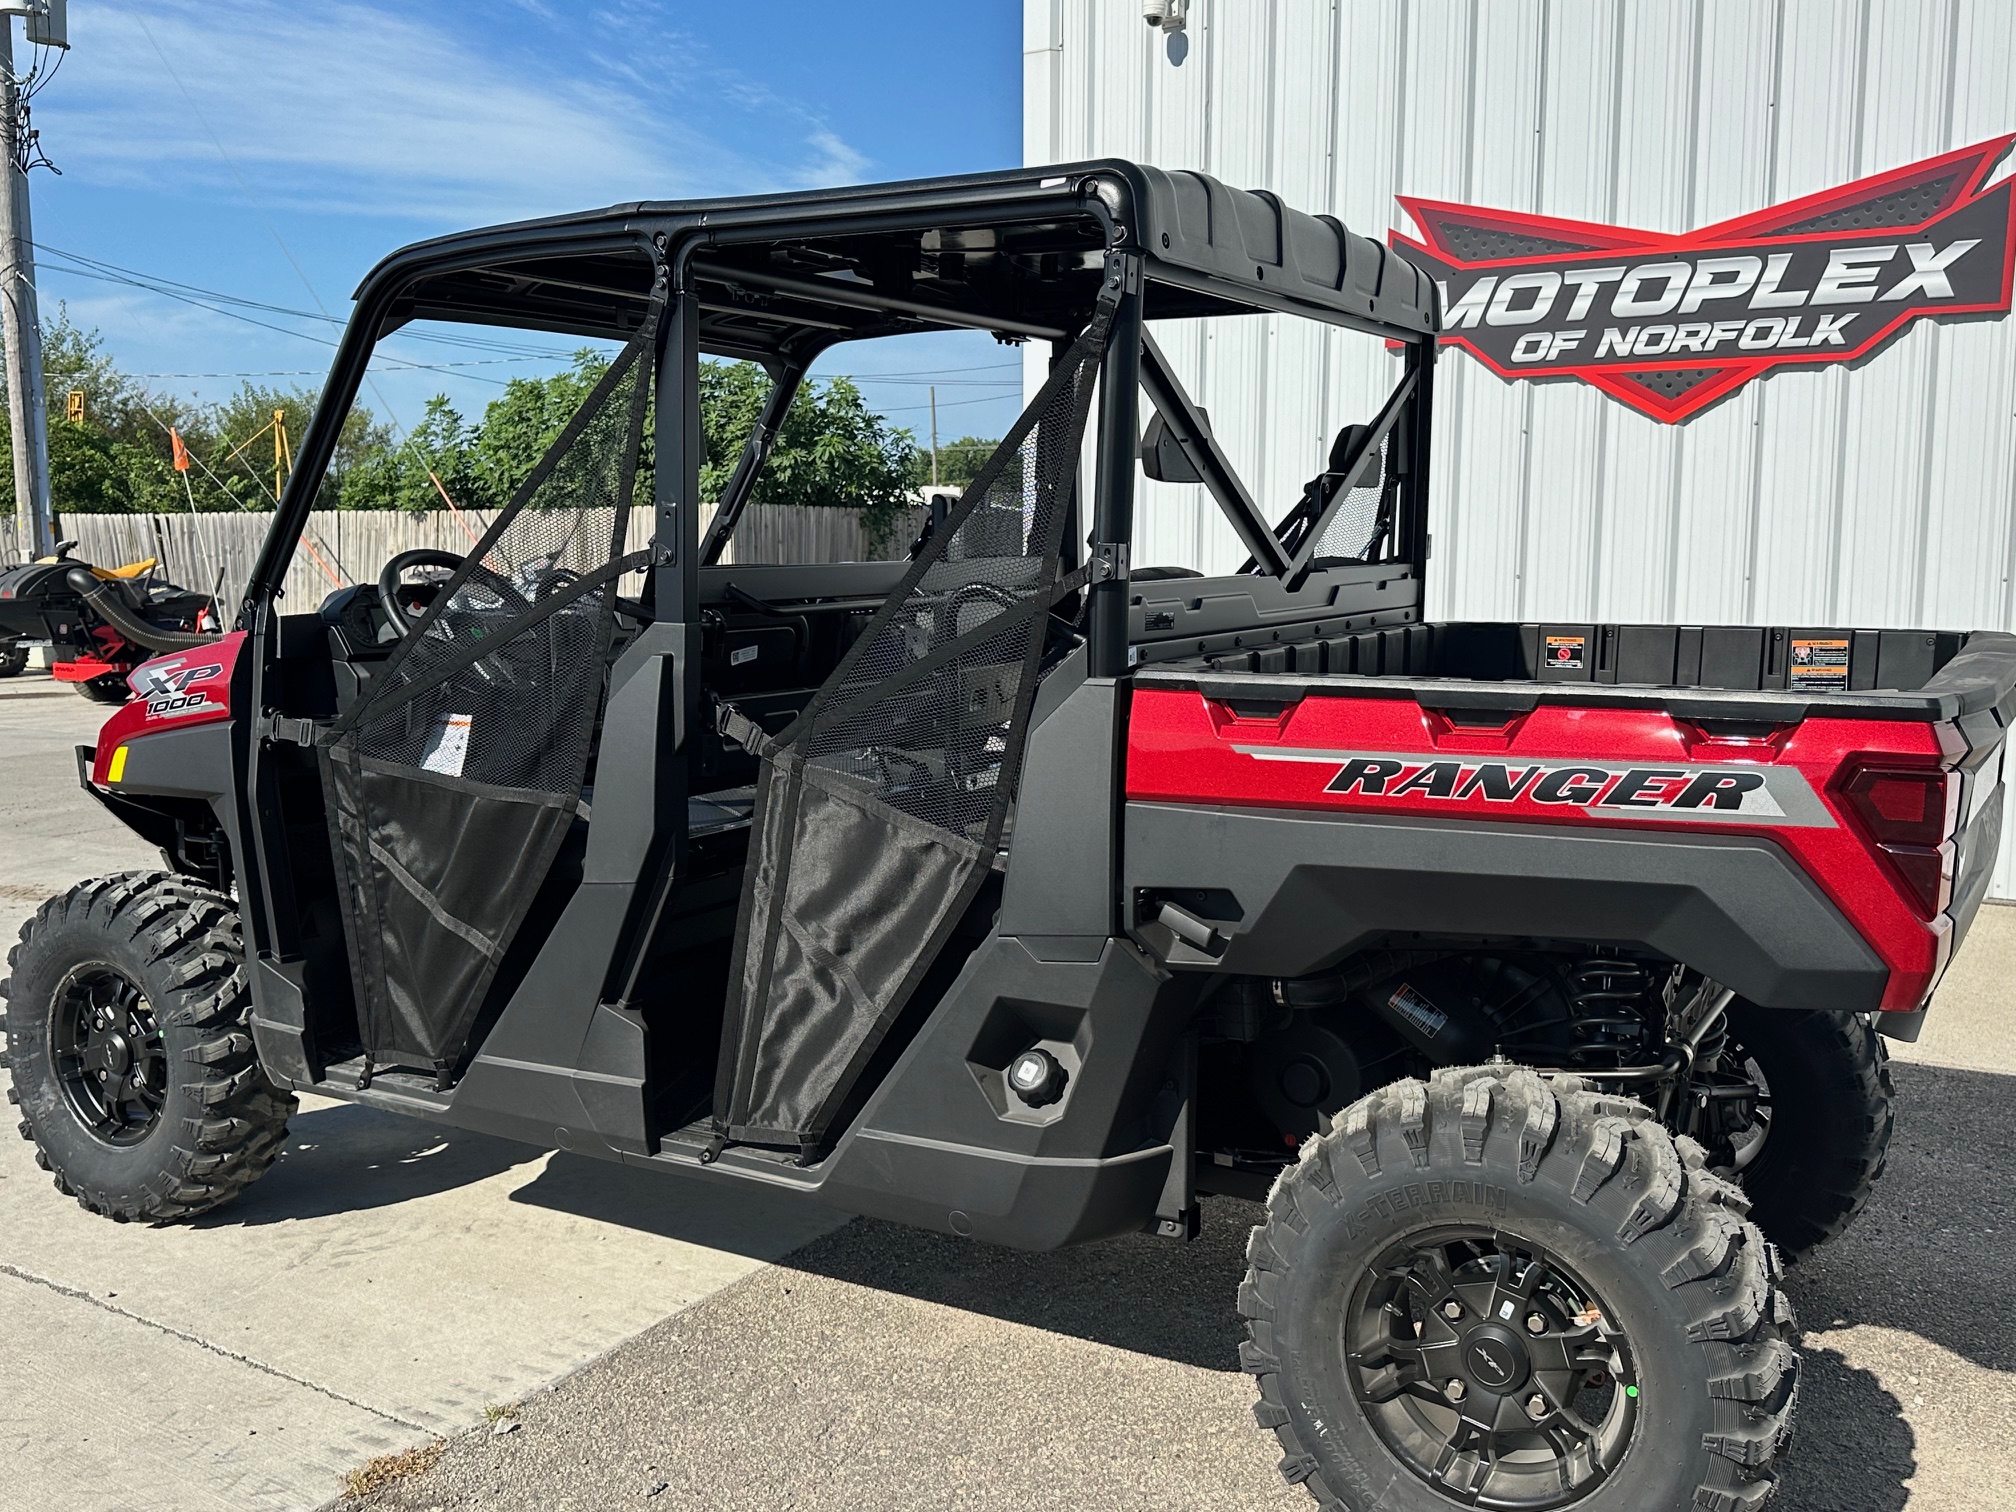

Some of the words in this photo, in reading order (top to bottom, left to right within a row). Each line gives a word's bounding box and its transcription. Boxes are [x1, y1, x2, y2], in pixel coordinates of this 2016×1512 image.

[1438, 238, 1984, 330] MOTOPLEX
[1509, 329, 1582, 363] OF
[1594, 312, 1860, 359] NORFOLK
[131, 663, 223, 704] XP
[145, 692, 207, 716] 1000
[1322, 756, 1767, 812] RANGER
[1336, 1179, 1507, 1241] X-TERRAIN
